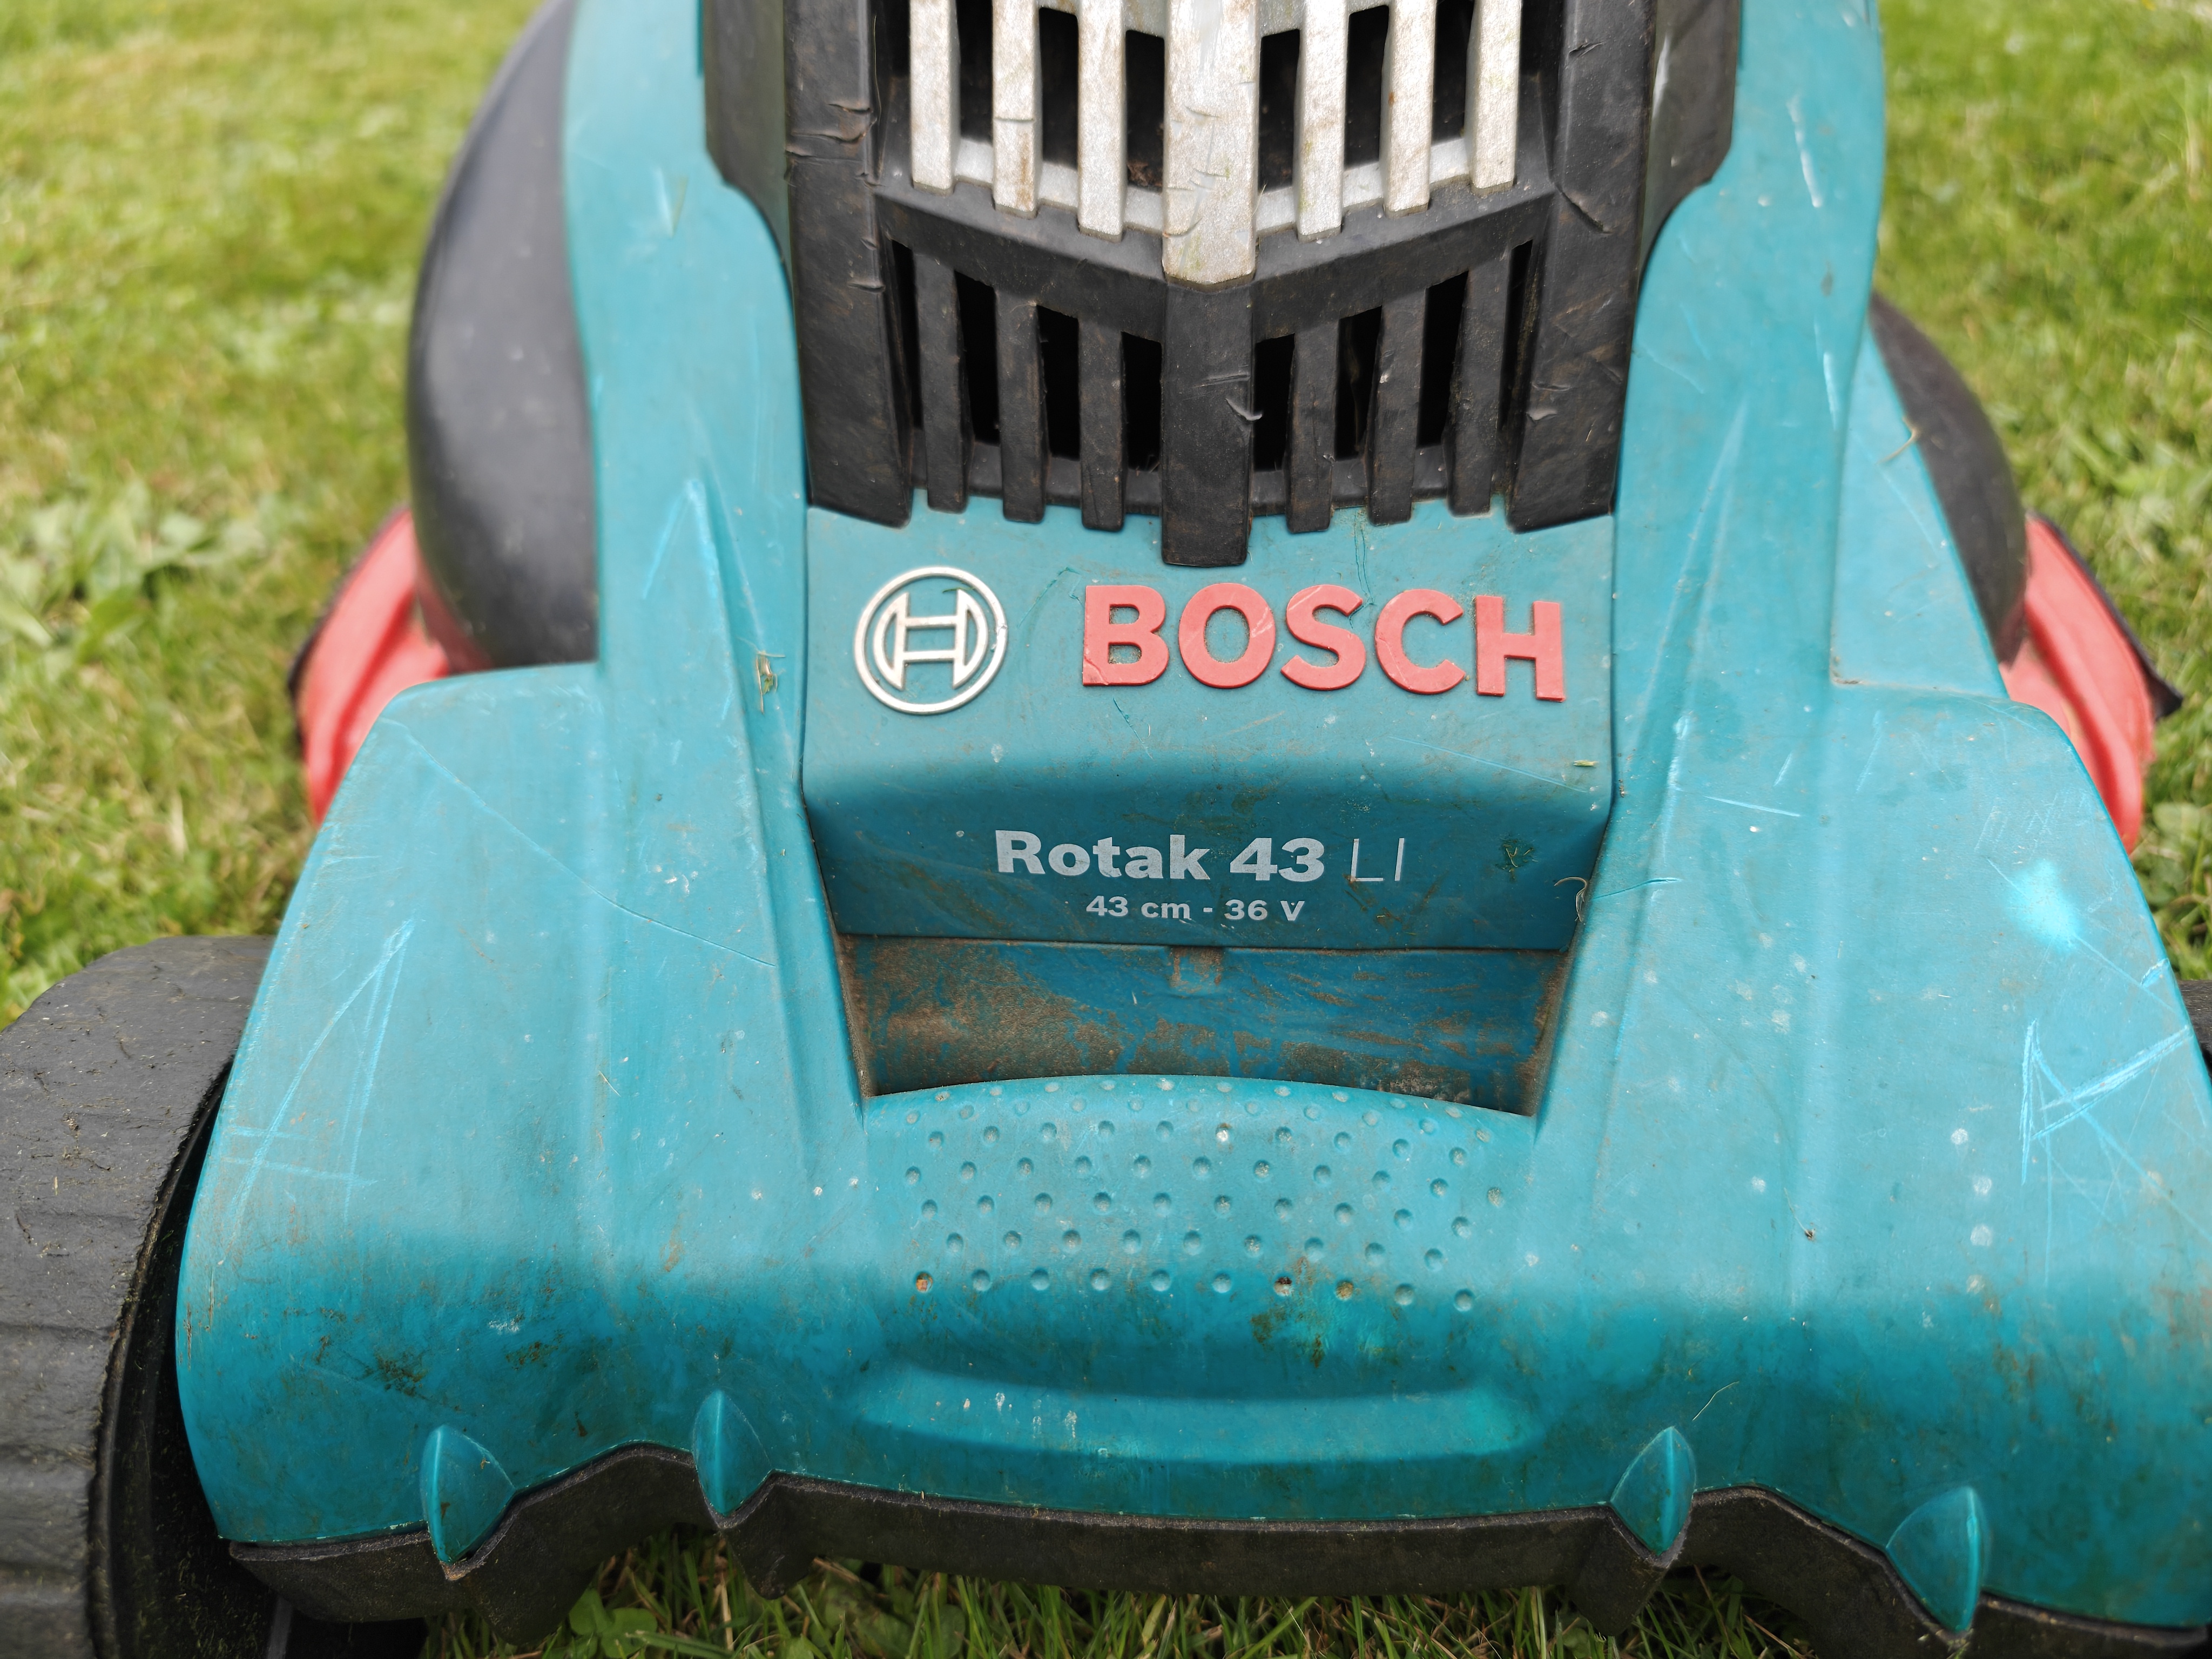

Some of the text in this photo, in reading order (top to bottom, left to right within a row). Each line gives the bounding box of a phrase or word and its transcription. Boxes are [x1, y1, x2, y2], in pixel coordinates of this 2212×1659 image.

[1082, 583, 1566, 702] BOSCH
[995, 830, 1405, 882] Rotak 43 LI
[1086, 896, 1129, 917] 43
[1141, 900, 1191, 920] cm
[1224, 899, 1268, 921] 36
[1280, 901, 1305, 921] V
